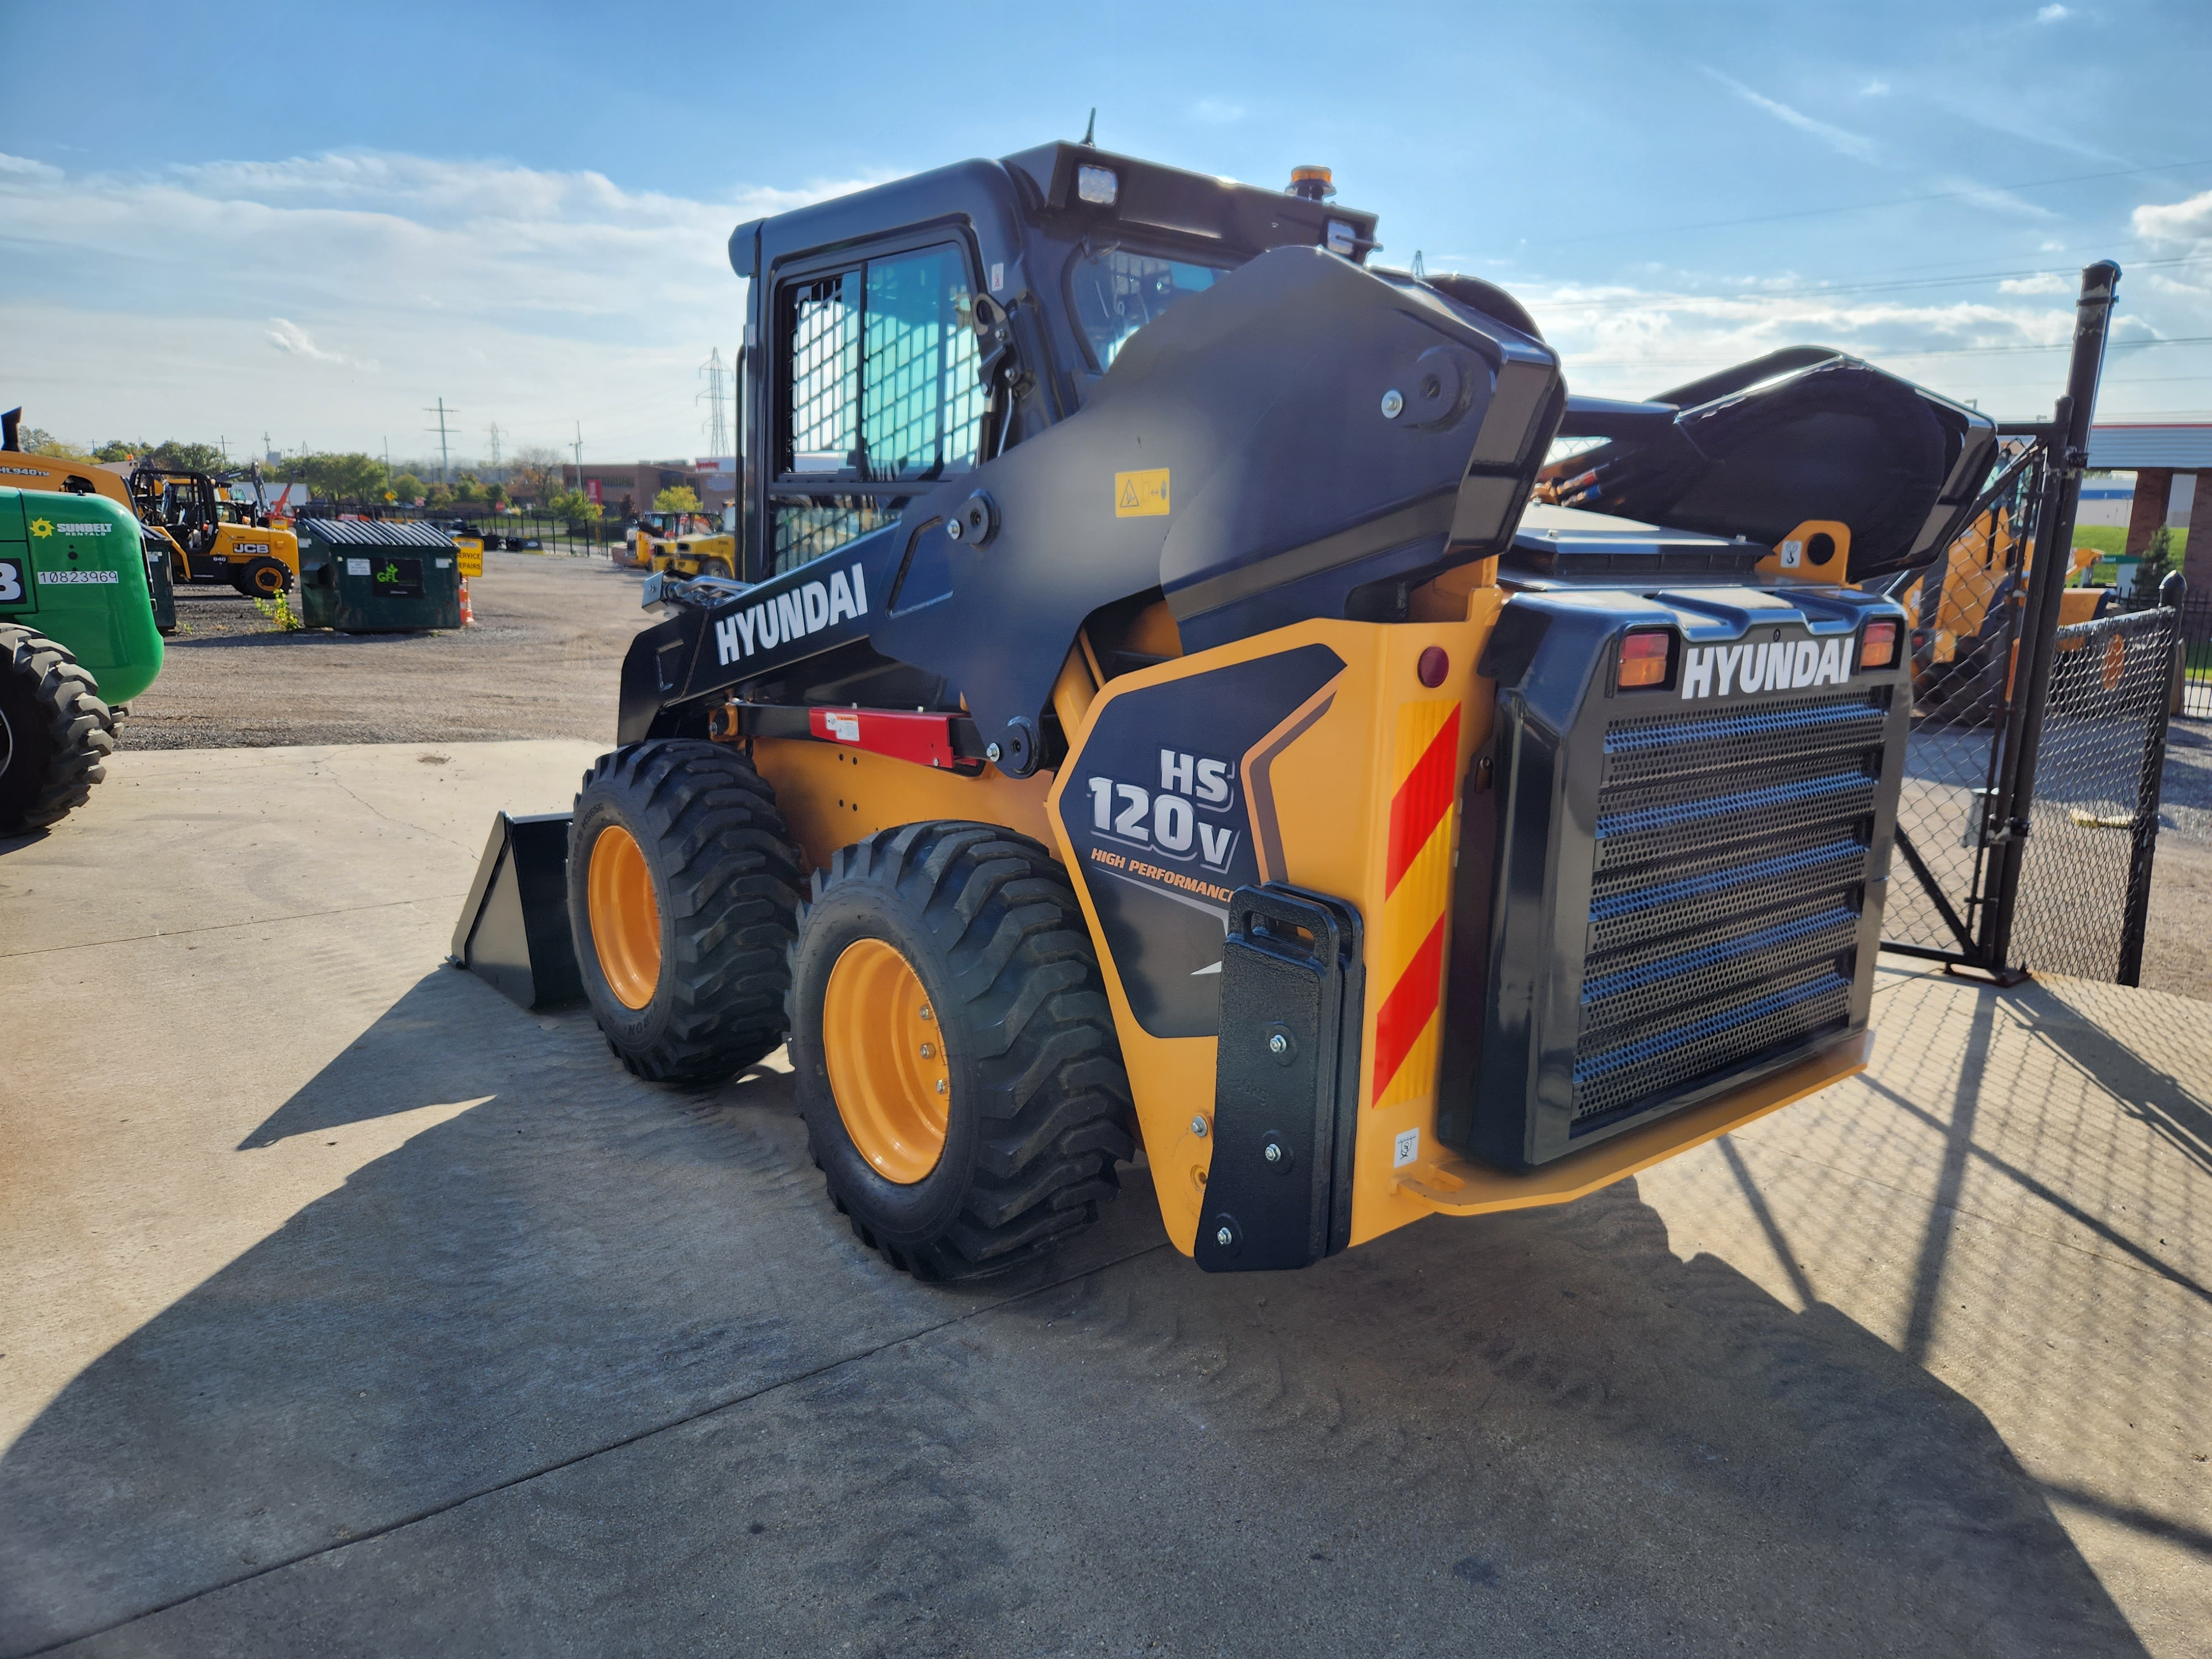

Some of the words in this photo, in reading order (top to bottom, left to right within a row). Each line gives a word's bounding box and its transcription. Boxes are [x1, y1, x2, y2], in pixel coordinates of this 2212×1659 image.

[56, 523, 112, 533] SUNBELT
[234, 544, 269, 554] JCB
[40, 571, 118, 583] 10823969
[377, 567, 399, 582] GFL
[714, 562, 868, 666] HYUNDAI
[1682, 637, 1855, 700] HYUNDAI
[1161, 749, 1228, 802] HS
[1091, 847, 1126, 869] HIGH
